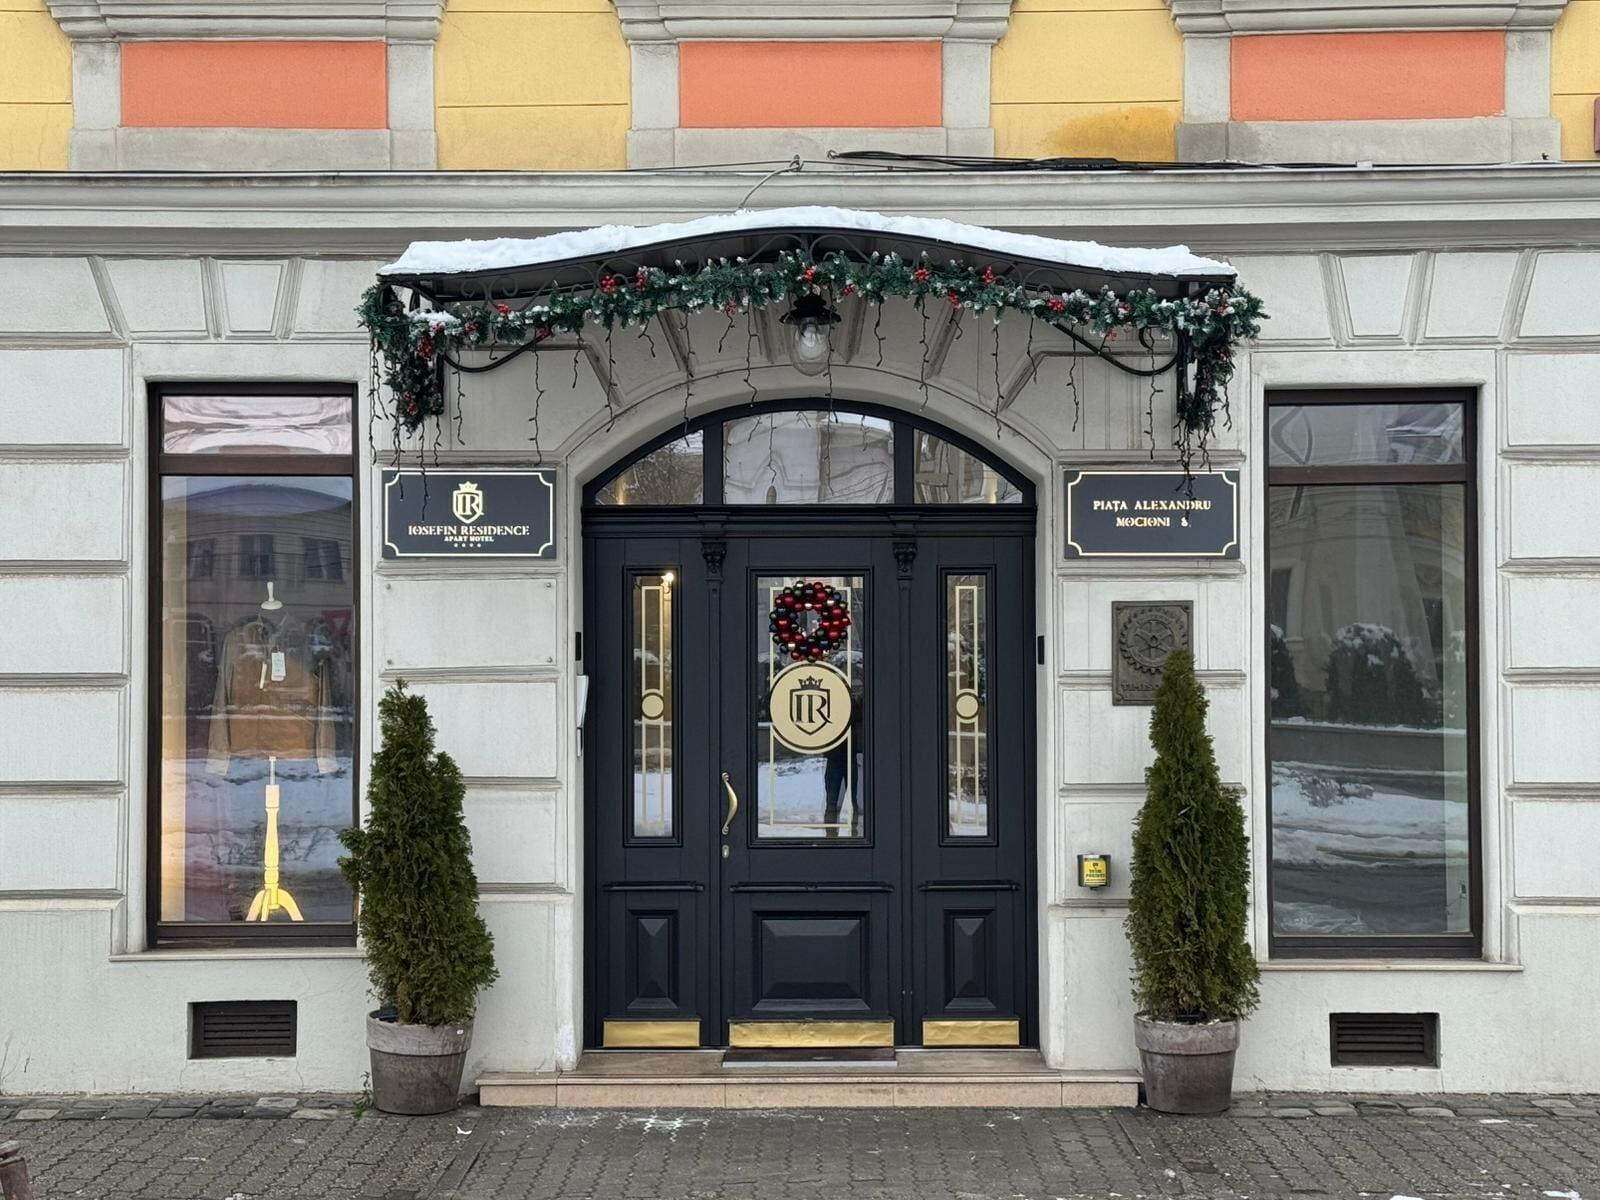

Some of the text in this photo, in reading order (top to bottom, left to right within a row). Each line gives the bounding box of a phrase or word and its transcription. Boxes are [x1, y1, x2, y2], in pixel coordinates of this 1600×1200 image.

[1134, 500, 1212, 511] ALEXANDRU
[1116, 516, 1170, 527] MOCIONI
[408, 525, 530, 536] IOSEFIN RESIDENCE
